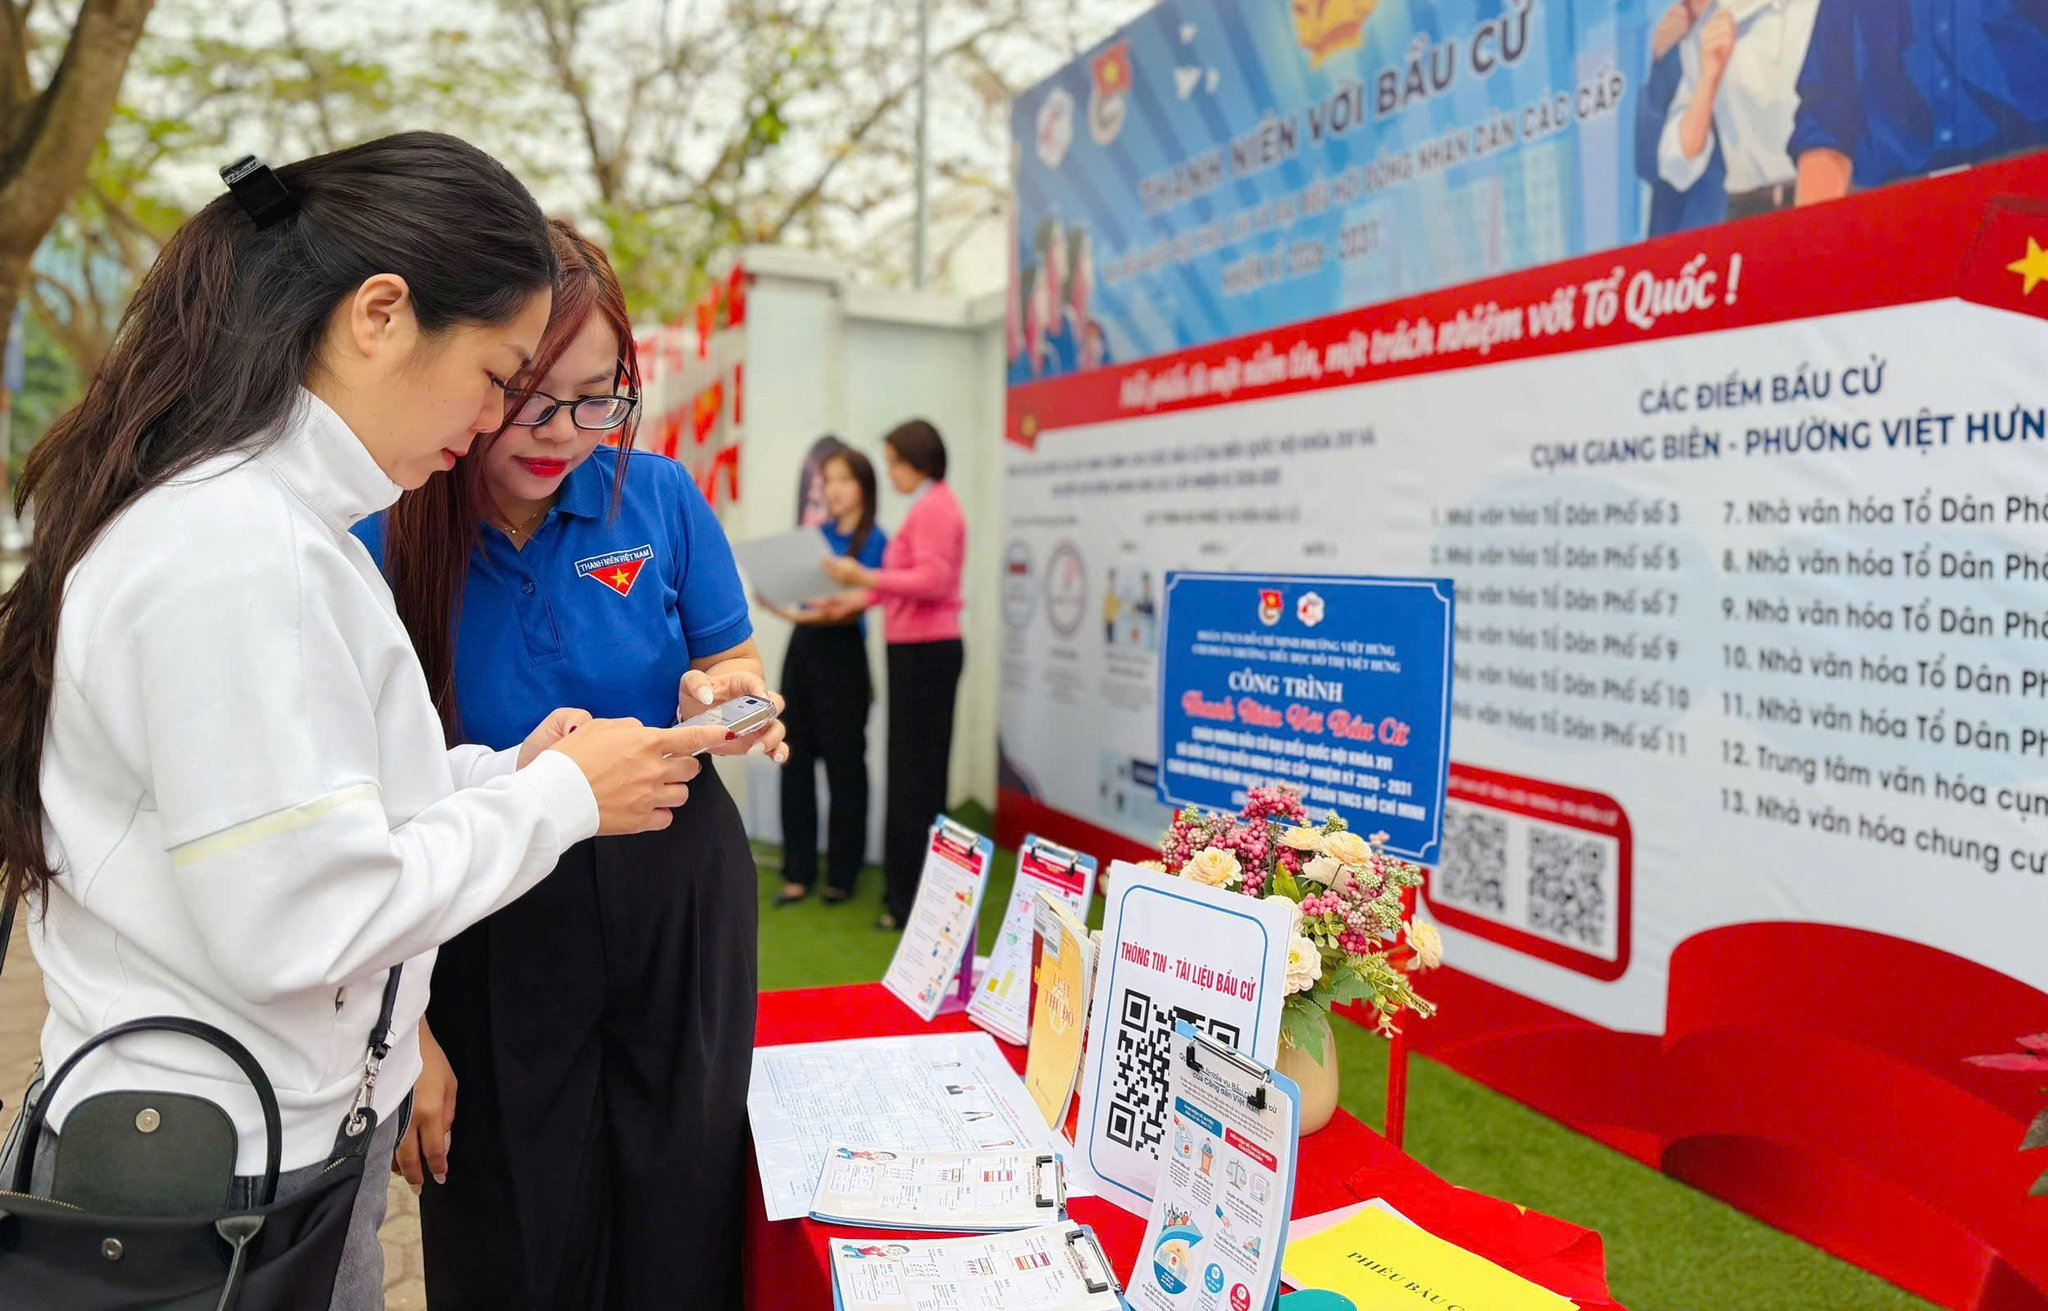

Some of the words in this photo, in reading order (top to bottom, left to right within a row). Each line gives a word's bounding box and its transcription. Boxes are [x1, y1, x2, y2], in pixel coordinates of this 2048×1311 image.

[1521, 89, 1569, 139] CÁC
[1528, 284, 1578, 336] với
[1582, 265, 1626, 329] Tổ
[1624, 252, 1718, 329] Quốc
[1724, 252, 1743, 305] !
[1638, 379, 1688, 416] CÁC
[1841, 353, 1888, 396] CỬ
[1583, 435, 1655, 466] GIANG
[1662, 427, 1720, 461] BIÊN
[1744, 416, 1872, 458] PHƯỜNG
[1881, 406, 1956, 457] VIỆT
[1722, 501, 1741, 524] 7.
[1748, 497, 1791, 524] Nhà
[1798, 500, 1840, 524] văn
[1848, 497, 1895, 524] hóa
[1902, 487, 1932, 524] Tổ
[1940, 493, 1996, 524] Dân
[580, 560, 604, 572] THANH
[633, 548, 649, 559] NAM
[1748, 547, 1791, 575] Nhà
[1798, 550, 1840, 575] văn
[1848, 549, 1894, 576] hóa
[1902, 541, 1932, 579] Tổ
[1940, 550, 1995, 580] Dân
[1747, 596, 1790, 625] Nhà
[1797, 600, 1840, 627] văn
[1847, 601, 1893, 631] hóa
[1902, 596, 1932, 634] Tổ
[1939, 606, 1994, 637] Dân
[1228, 667, 1280, 696] CÔNG
[1282, 673, 1344, 703] TRÌNH
[1722, 644, 1752, 671] 10.
[1759, 647, 1802, 675] Nhà
[1810, 651, 1853, 680] văn
[1860, 654, 1909, 685] hóa
[1917, 652, 1947, 688] Tổ
[1955, 663, 2012, 696] Dân
[1722, 691, 1752, 719] 11.
[1758, 696, 1802, 726] Nhà
[1809, 701, 1853, 732] văn
[1859, 707, 1908, 740] hóa
[1916, 707, 1946, 745] Tổ
[1954, 719, 2011, 753] Dân
[1721, 739, 1751, 767] 12.
[1757, 745, 1817, 785] Trung
[1824, 753, 1872, 787] tâm
[1878, 764, 1926, 796] văn
[1935, 769, 1986, 806] hóa
[1720, 787, 1750, 817] 13.
[1756, 793, 1801, 827] Nhà
[1807, 805, 1852, 838] văn
[1858, 813, 1907, 848] hóa
[1914, 827, 2001, 875] chung
[1120, 941, 1151, 968] THÔNG
[1151, 951, 1168, 973] TIN
[1175, 957, 1191, 981] TÀI
[1191, 964, 1215, 991] LIỆU
[1215, 969, 1239, 997] BẦU
[1239, 976, 1257, 1002] CỬ
[1347, 1251, 1405, 1283] PHIẾU
[1404, 1281, 1447, 1305] BẦU
